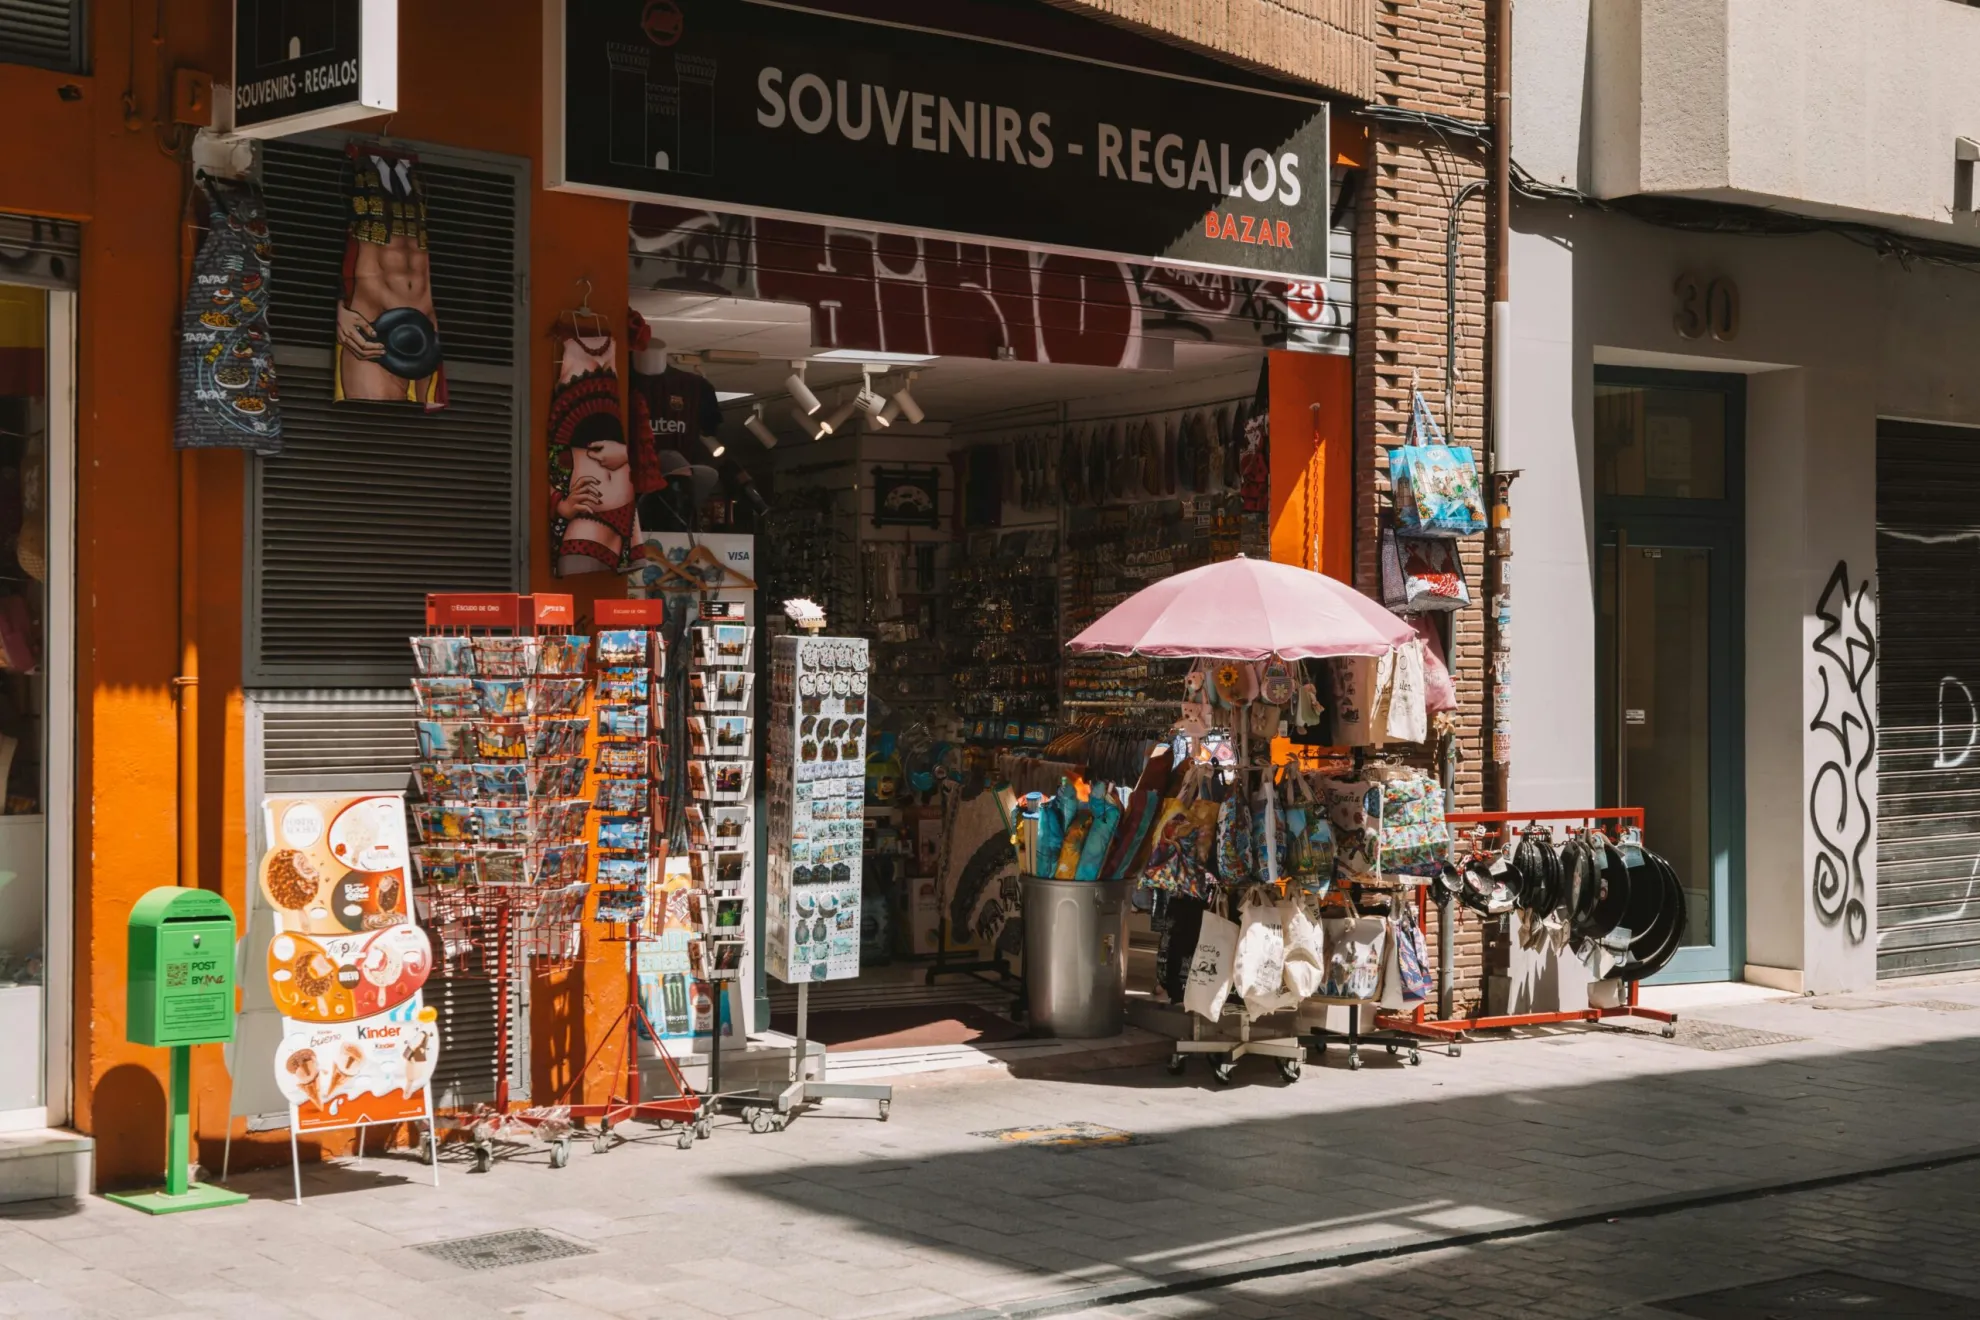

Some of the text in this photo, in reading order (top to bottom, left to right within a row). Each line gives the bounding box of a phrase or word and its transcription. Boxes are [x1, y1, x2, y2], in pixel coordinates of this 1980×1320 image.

[236, 72, 296, 109] SOUVENIRS
[305, 58, 358, 93] REGALOS
[757, 66, 1054, 169] SOUVENIRS
[1098, 122, 1301, 207] REGALOS
[1205, 210, 1294, 249] BAZAR
[197, 274, 229, 284] TAPAS
[1672, 272, 1739, 342] 30
[183, 331, 217, 342] TAPAS
[195, 389, 228, 400] TAPAS
[650, 418, 686, 434] uten
[727, 551, 750, 561] VISA
[191, 961, 216, 971] POST
[191, 975, 203, 985] BY
[310, 1033, 342, 1047] bueno
